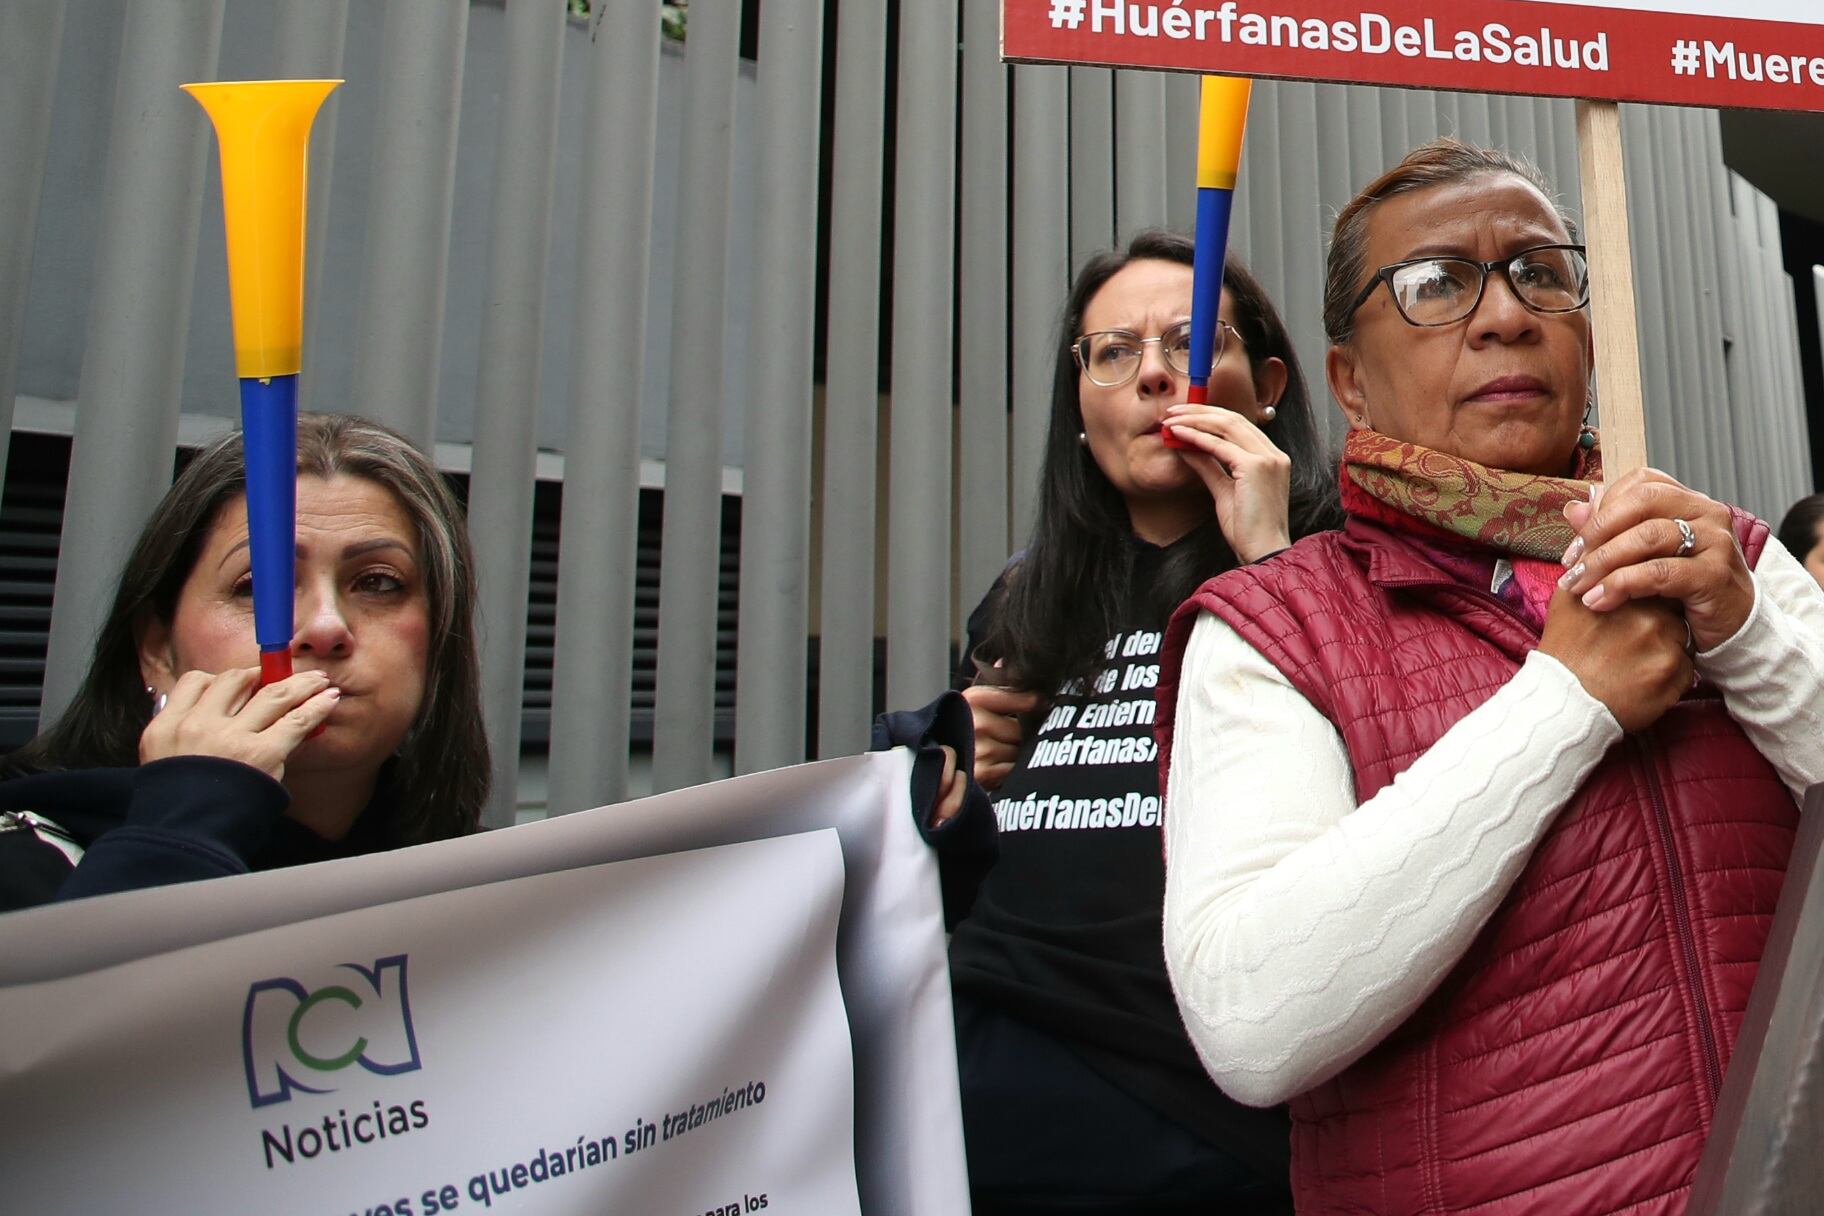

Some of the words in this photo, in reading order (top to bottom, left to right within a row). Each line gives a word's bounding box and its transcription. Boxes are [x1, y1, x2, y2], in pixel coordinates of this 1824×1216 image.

[1120, 663, 1160, 692] los
[991, 791, 1163, 834] HuérfanasDe
[260, 1097, 429, 1170] Noticias
[421, 1183, 460, 1216] se
[468, 1133, 619, 1207] quedarían
[623, 1117, 658, 1155] sin
[661, 1080, 767, 1141] tratamiento
[743, 1191, 769, 1213] los
